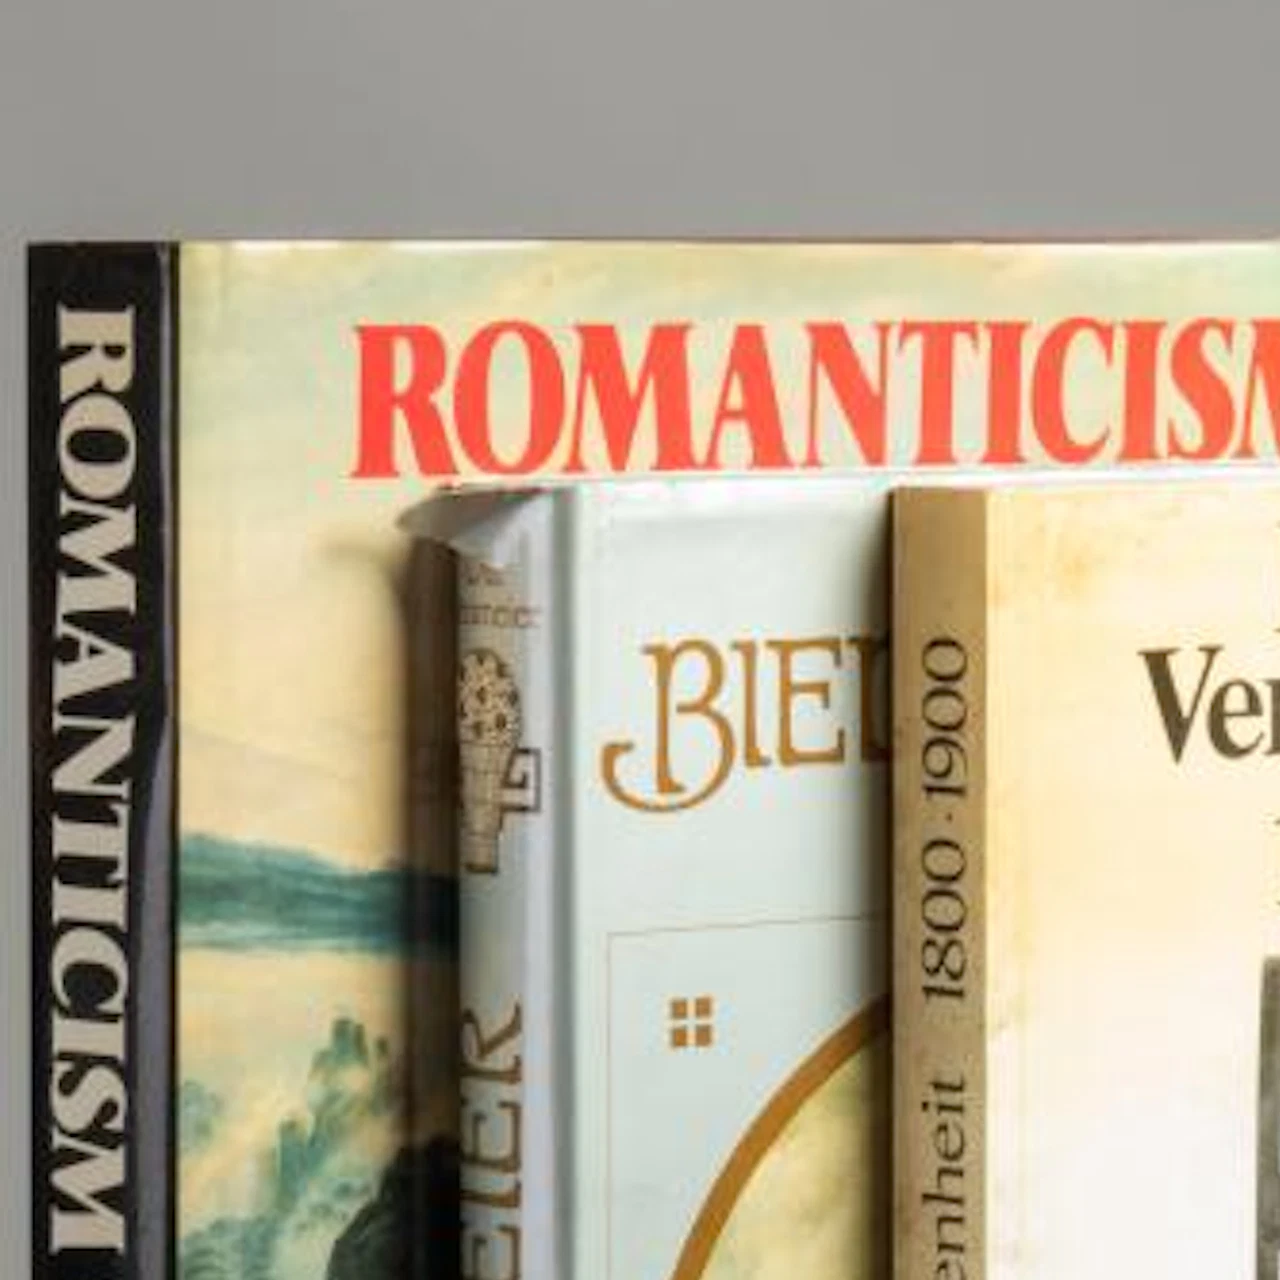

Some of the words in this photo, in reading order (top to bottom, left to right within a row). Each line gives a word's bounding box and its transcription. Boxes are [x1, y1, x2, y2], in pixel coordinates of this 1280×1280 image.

[49, 304, 138, 1255] ROMANTICISM
[920, 636, 968, 798] 1900
[920, 837, 966, 1000] 1800
